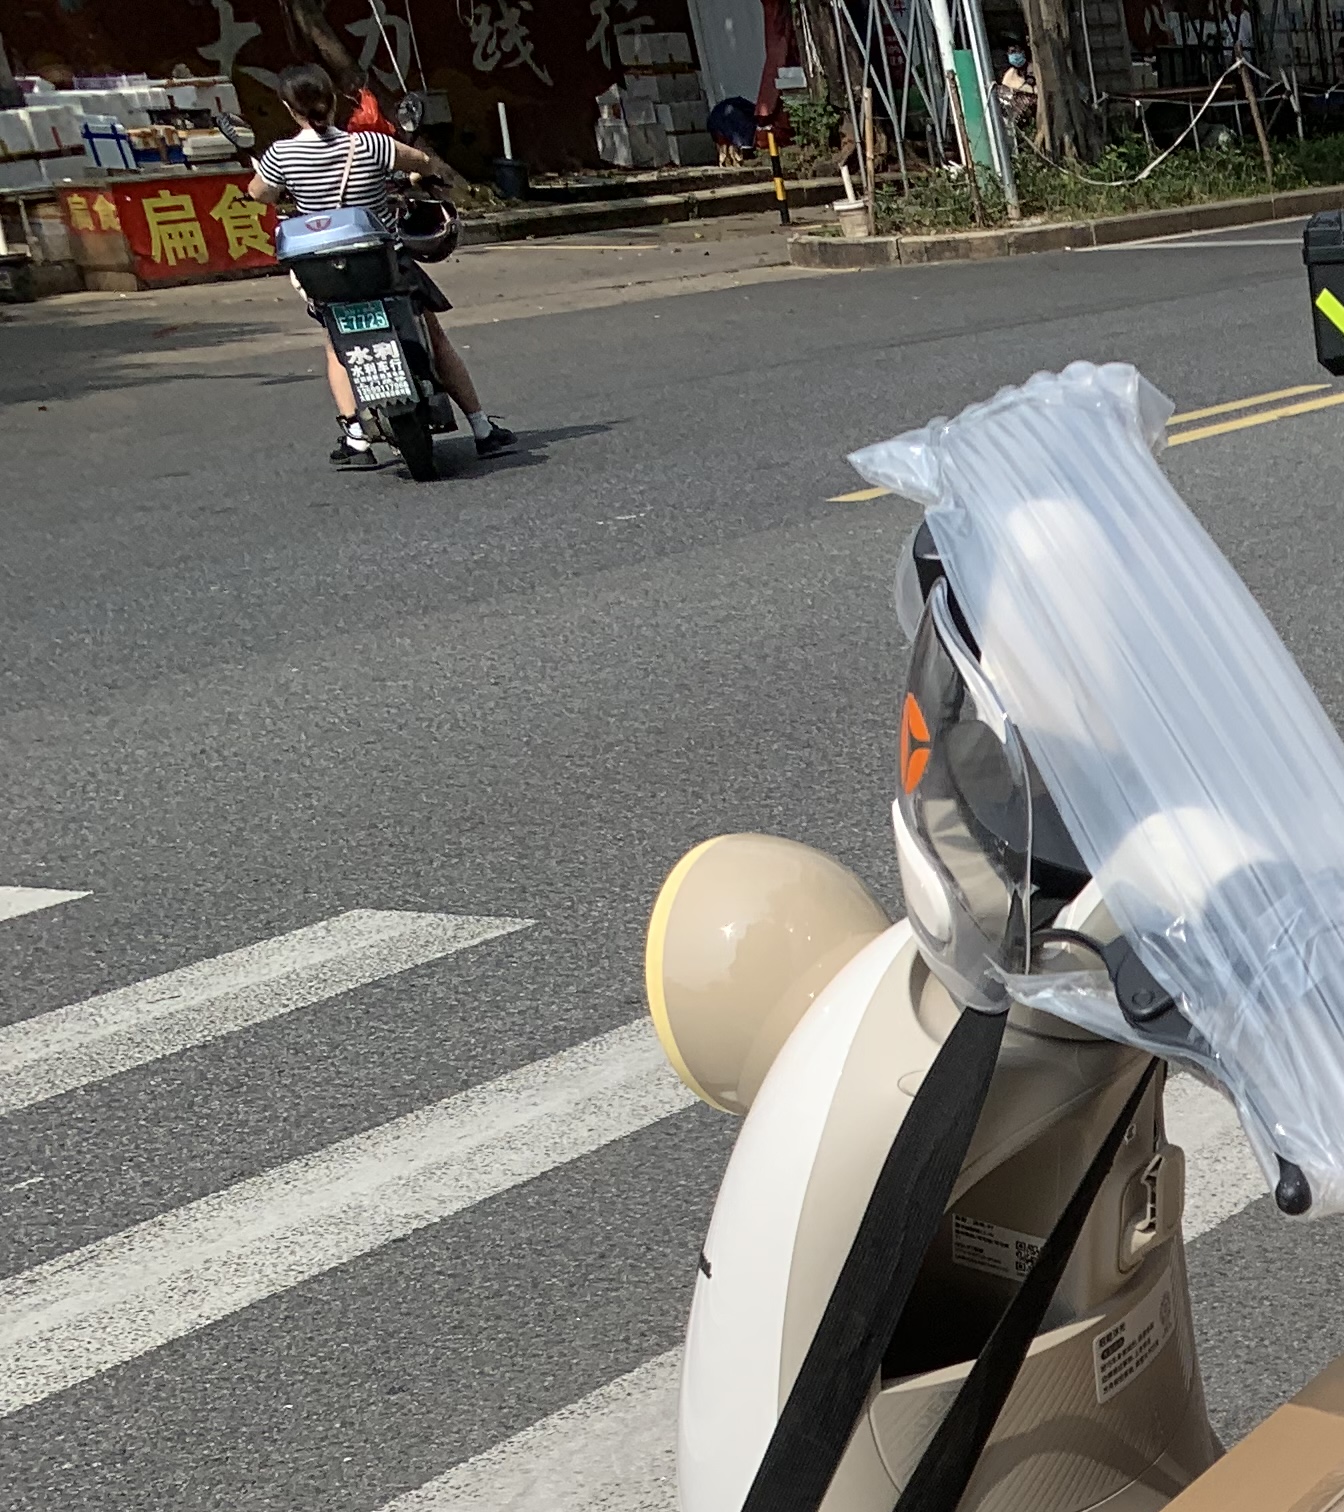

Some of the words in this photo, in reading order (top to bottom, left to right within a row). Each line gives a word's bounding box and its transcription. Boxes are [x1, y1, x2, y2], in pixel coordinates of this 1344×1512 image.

[67, 194, 121, 231] 扁食
[142, 184, 276, 266] 扁食
[338, 312, 386, 331] E7725
[346, 340, 400, 364] 水利
